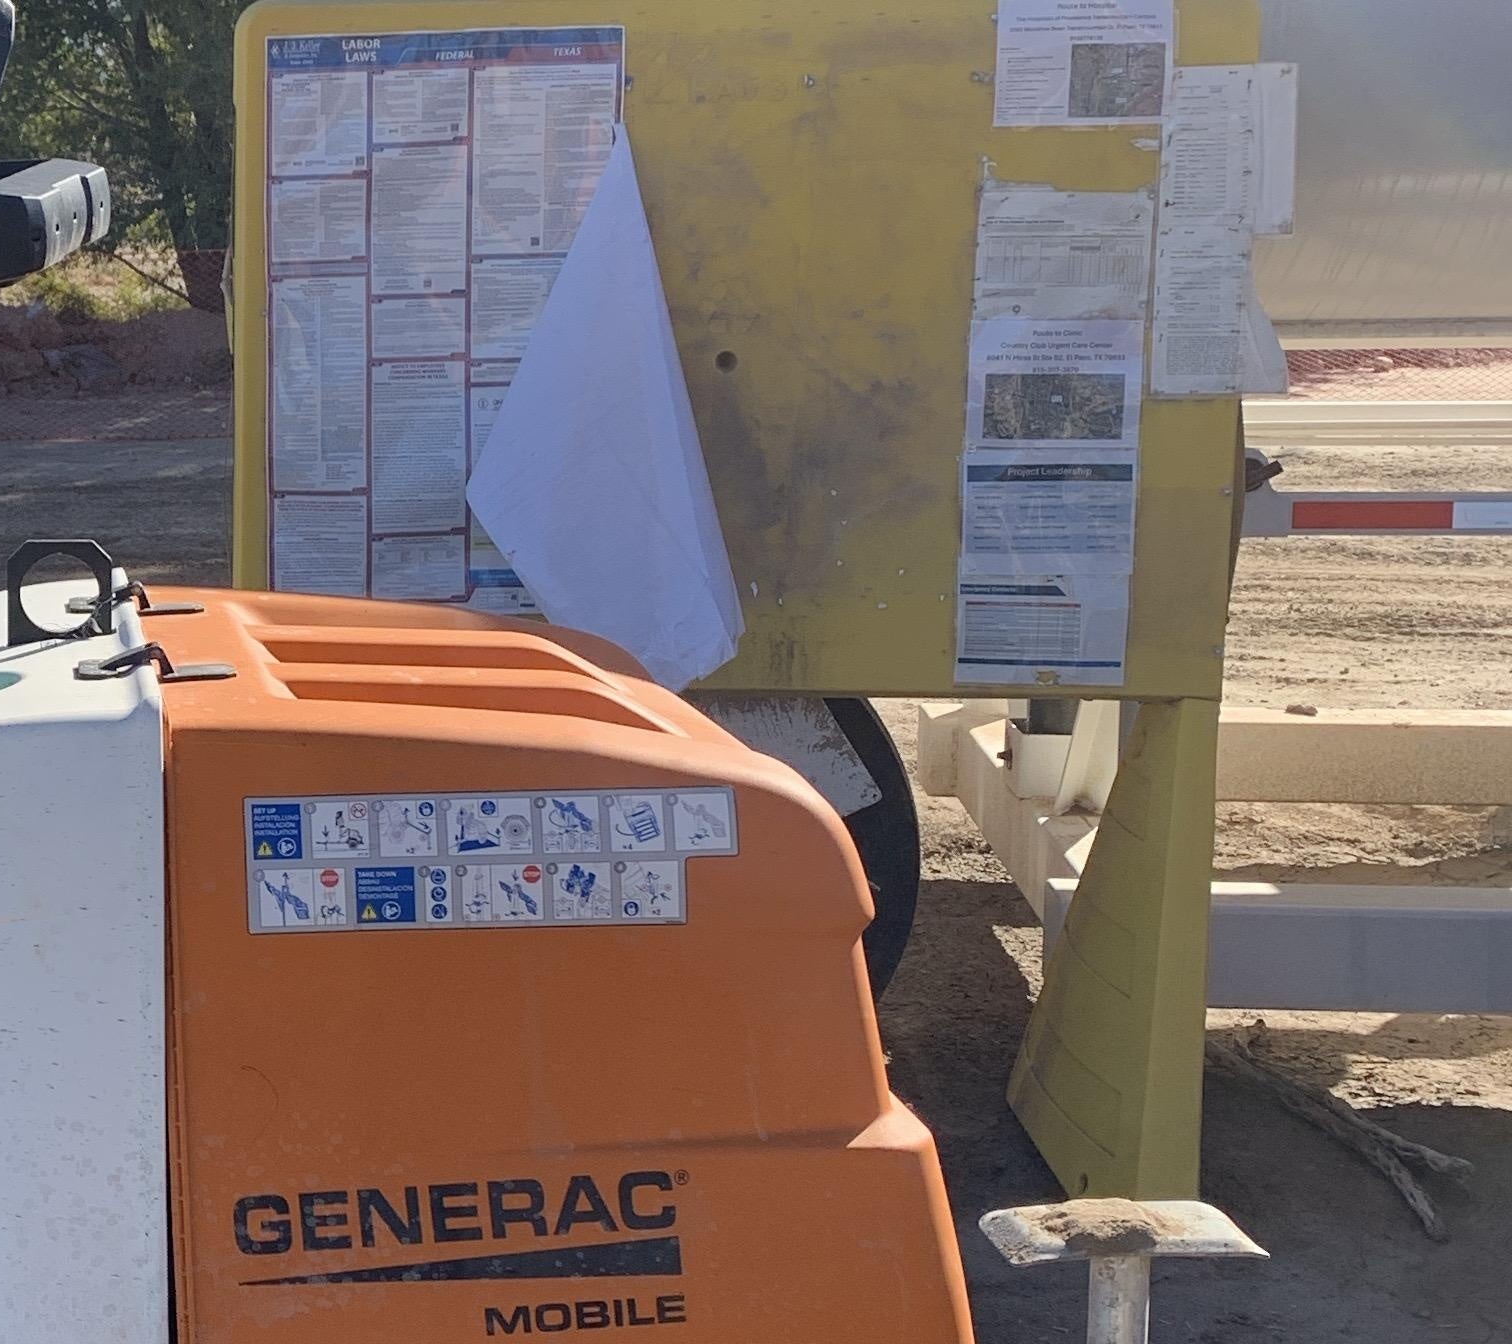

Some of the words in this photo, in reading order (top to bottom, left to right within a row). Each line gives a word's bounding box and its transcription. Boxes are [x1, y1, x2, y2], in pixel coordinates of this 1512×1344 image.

[341, 39, 381, 50] LABOR
[345, 51, 378, 63] LAWS
[435, 49, 474, 61] FEDERAL
[552, 46, 583, 57] TEXAS
[1007, 467, 1039, 477] Project
[1041, 467, 1093, 477] Leadership
[232, 1170, 678, 1257] GENERAC
[484, 1294, 687, 1336] MOBILE
